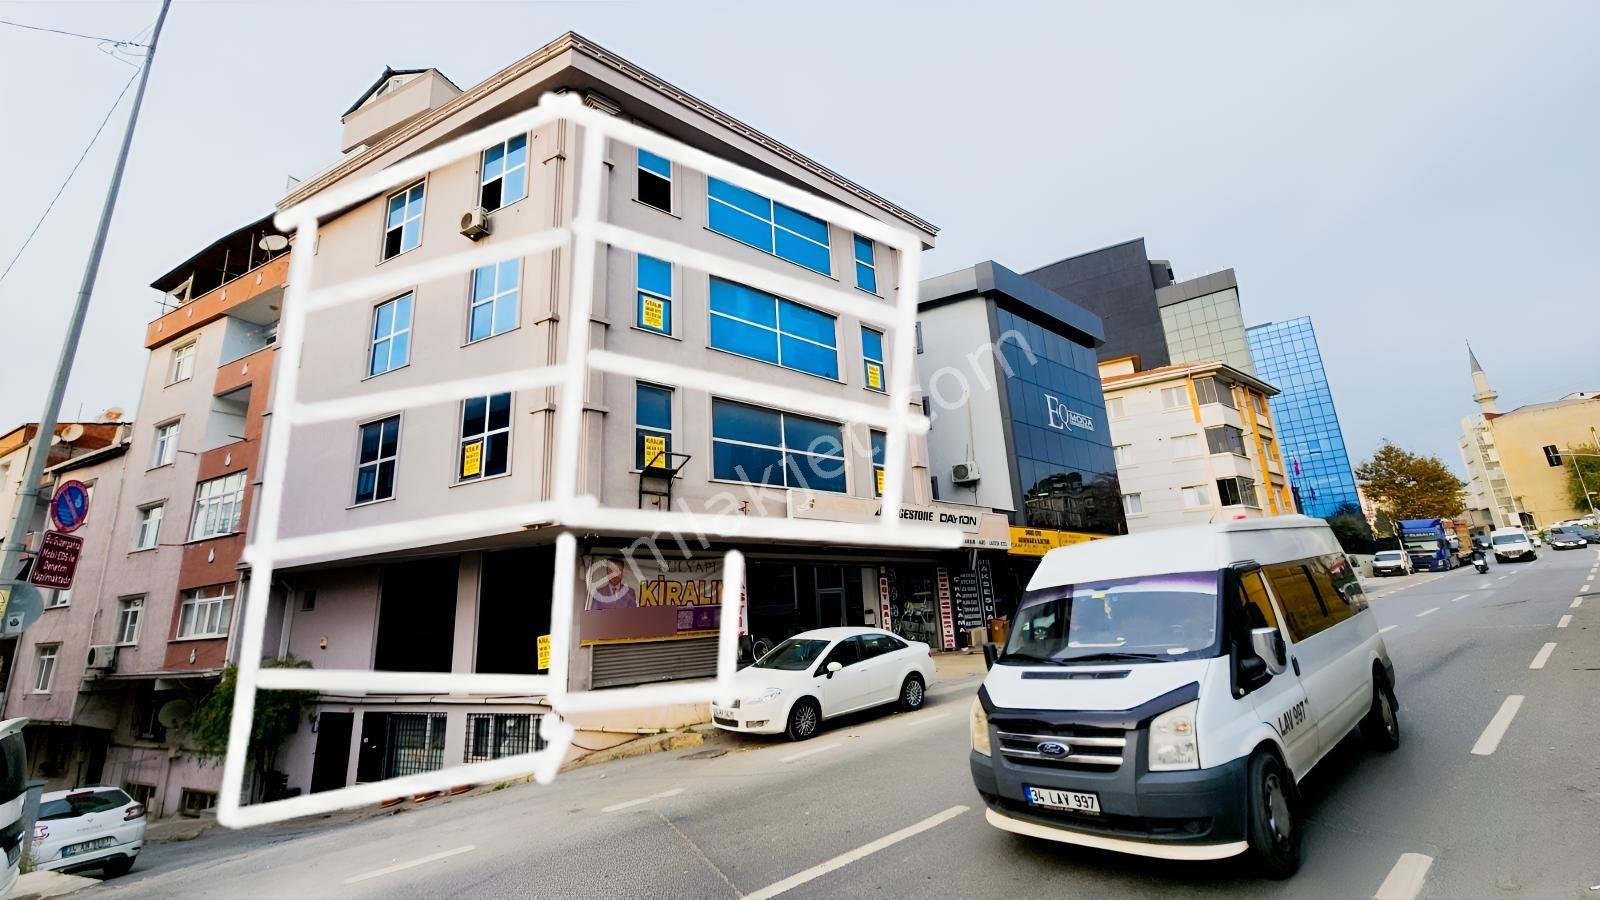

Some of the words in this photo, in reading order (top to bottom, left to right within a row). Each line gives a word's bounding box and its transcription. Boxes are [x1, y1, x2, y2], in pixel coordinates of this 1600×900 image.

[939, 513, 977, 526] DAYTON
[638, 575, 724, 607] KİRALI
[1031, 789, 1045, 803] 34
[1074, 794, 1095, 809] 997
